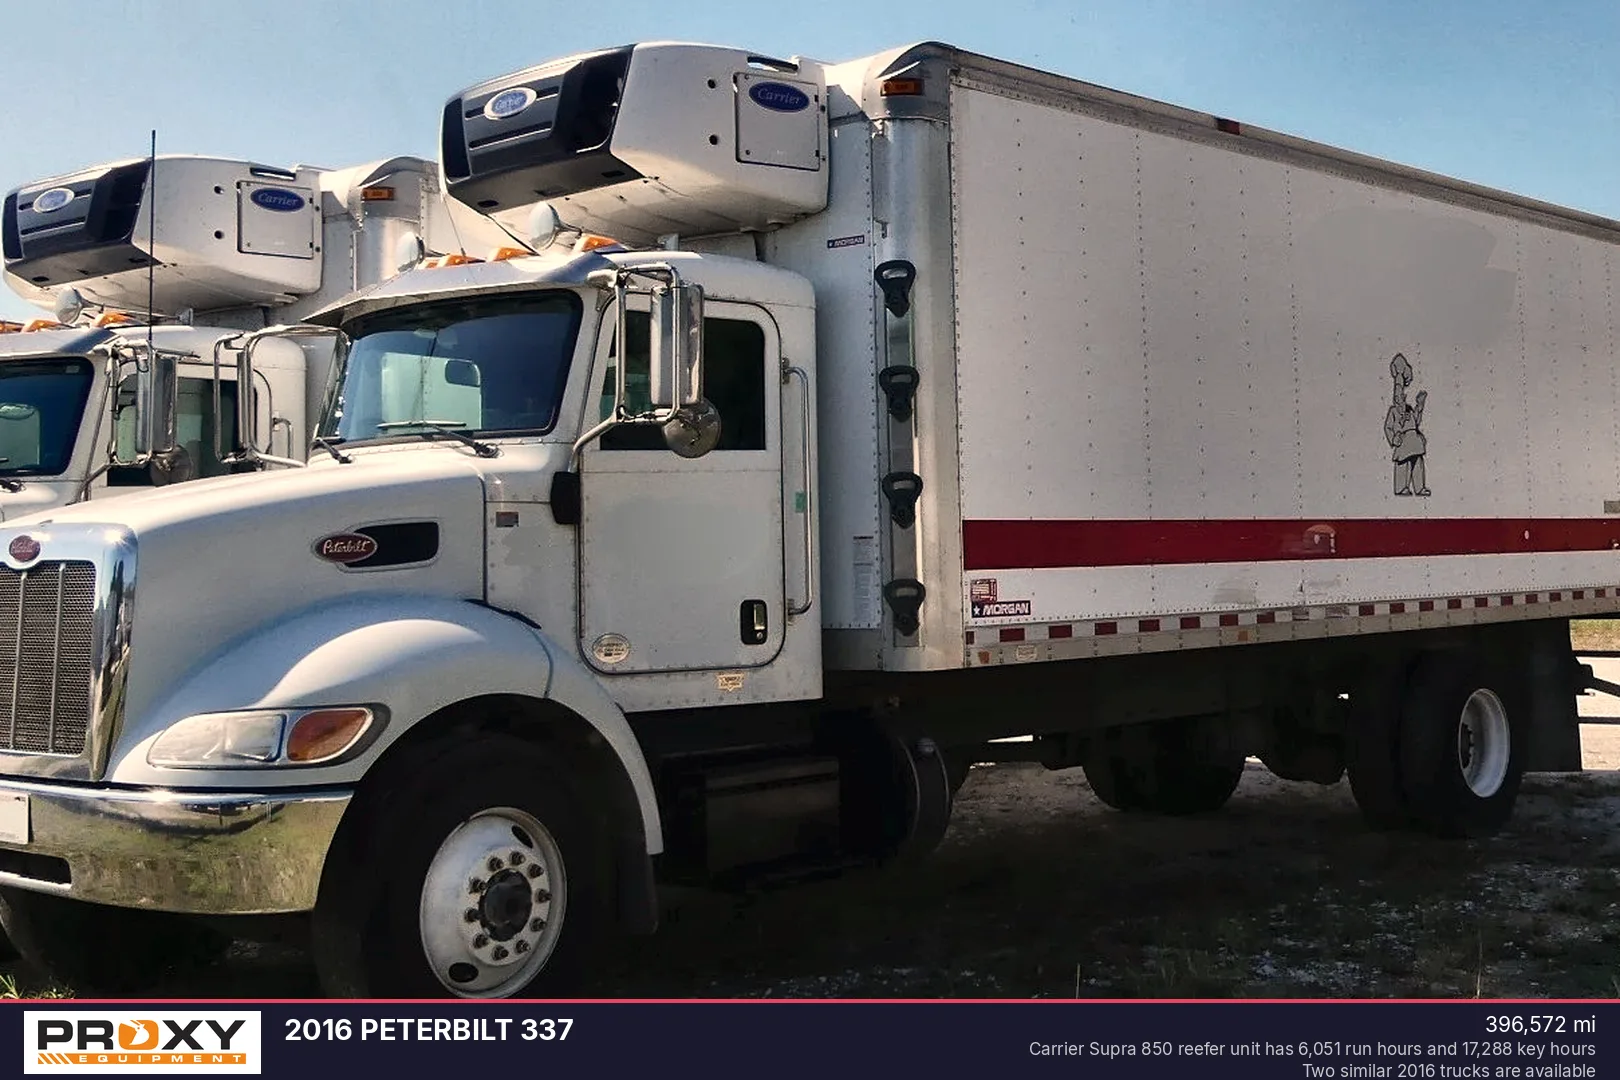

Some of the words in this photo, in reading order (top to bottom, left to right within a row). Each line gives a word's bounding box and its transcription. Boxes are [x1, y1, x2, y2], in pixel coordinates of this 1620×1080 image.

[758, 88, 800, 104] Carrier
[258, 192, 298, 206] Carrier
[322, 539, 371, 555] Peterbilt
[982, 602, 1030, 616] MORGAN
